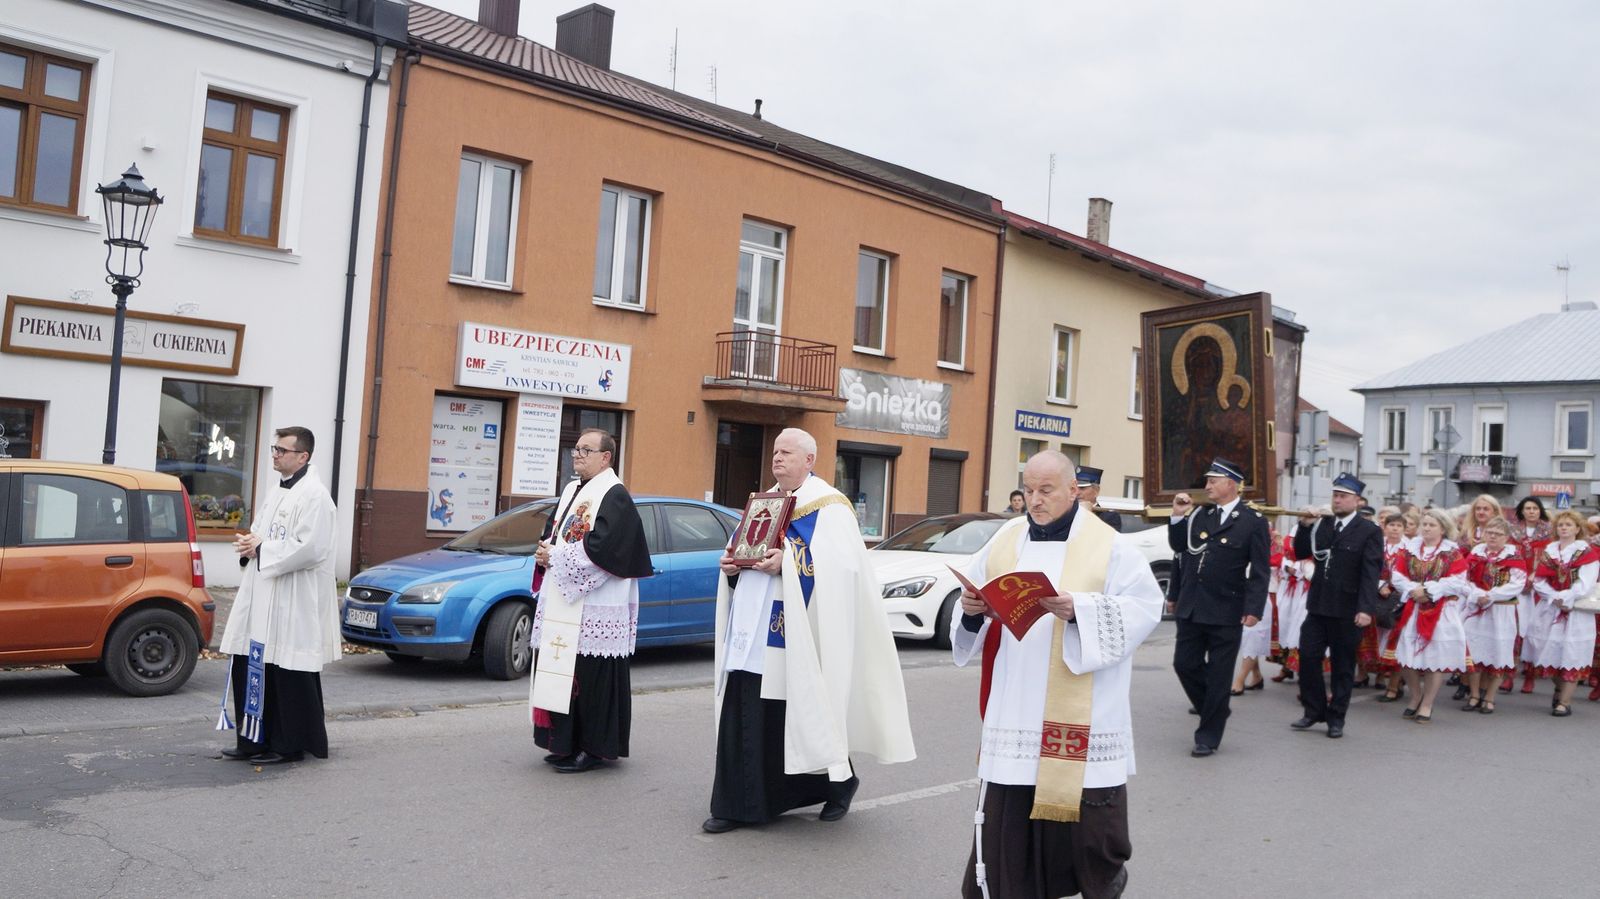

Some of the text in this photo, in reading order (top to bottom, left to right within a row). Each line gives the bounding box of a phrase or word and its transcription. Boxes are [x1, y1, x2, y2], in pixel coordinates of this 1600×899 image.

[18, 317, 102, 342] PIEKARNIA
[152, 332, 227, 355] CUKIERNIA
[473, 328, 622, 362] UBEZPIECZENIA
[466, 357, 486, 369] CMF
[521, 354, 579, 368] KRYSTIAN SAWICKI
[505, 377, 589, 396] INWESTYCJE
[450, 402, 467, 413] CMF
[521, 402, 559, 410] UBEZPIECZENIA
[522, 410, 556, 418] INWESTYCJE
[1017, 413, 1068, 434] PIEKARNIA
